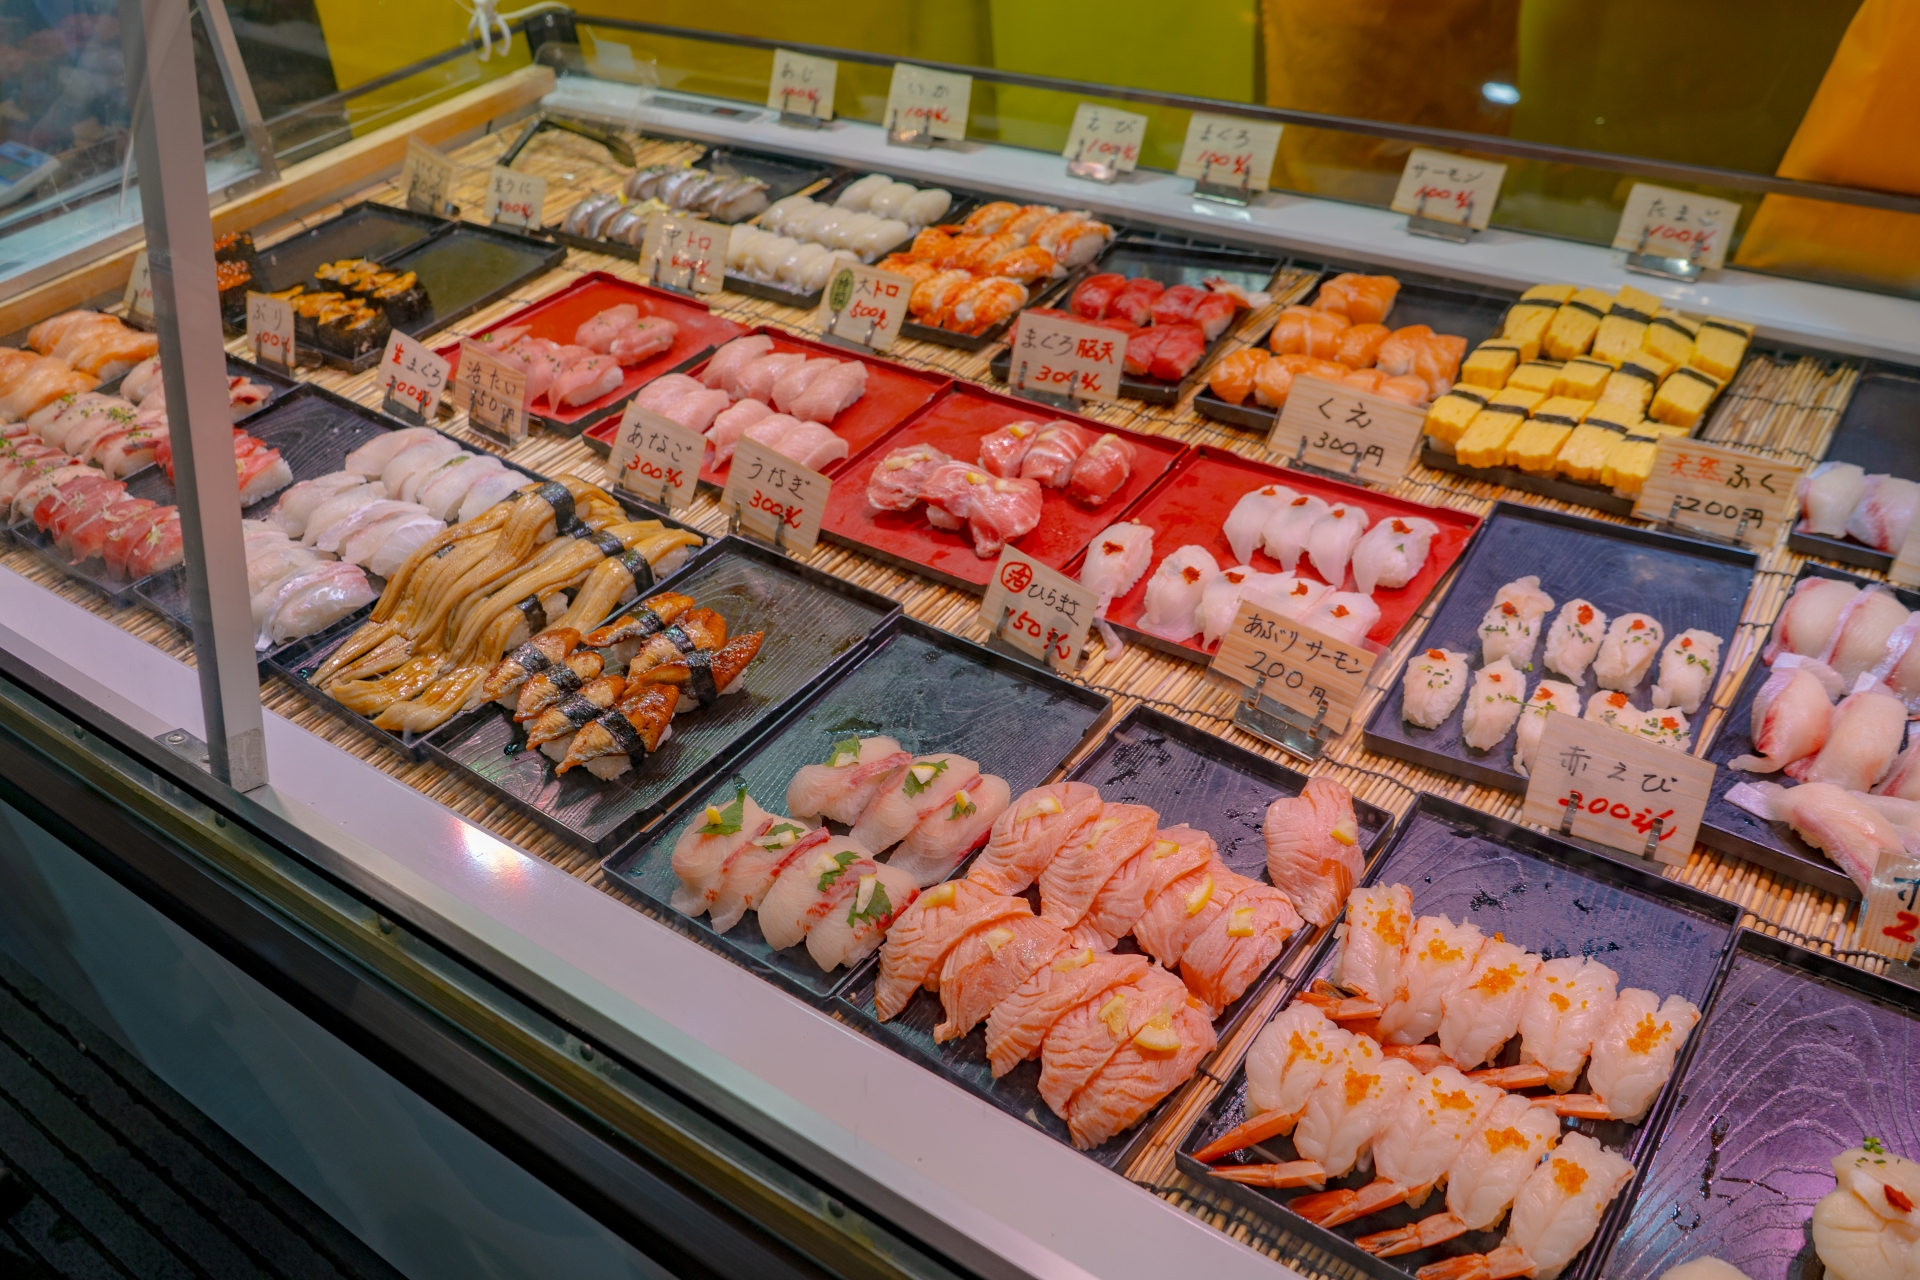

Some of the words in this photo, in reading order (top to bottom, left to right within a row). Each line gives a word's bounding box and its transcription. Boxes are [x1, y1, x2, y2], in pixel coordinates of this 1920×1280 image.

[1411, 163, 1484, 183] サーモン
[1648, 197, 1720, 226] たまご
[667, 229, 712, 250] 中トロ
[855, 278, 899, 298] 大トロ
[252, 302, 283, 331] ぶり
[392, 343, 442, 388] 生まぐろ
[466, 361, 517, 395] 活たい
[1318, 397, 1372, 428] くえ
[627, 422, 692, 463] あなご
[1313, 431, 1384, 467] 300円
[748, 456, 811, 501] うなぎ
[1245, 650, 1327, 705] 200円
[1559, 745, 1678, 793] 赤えび
